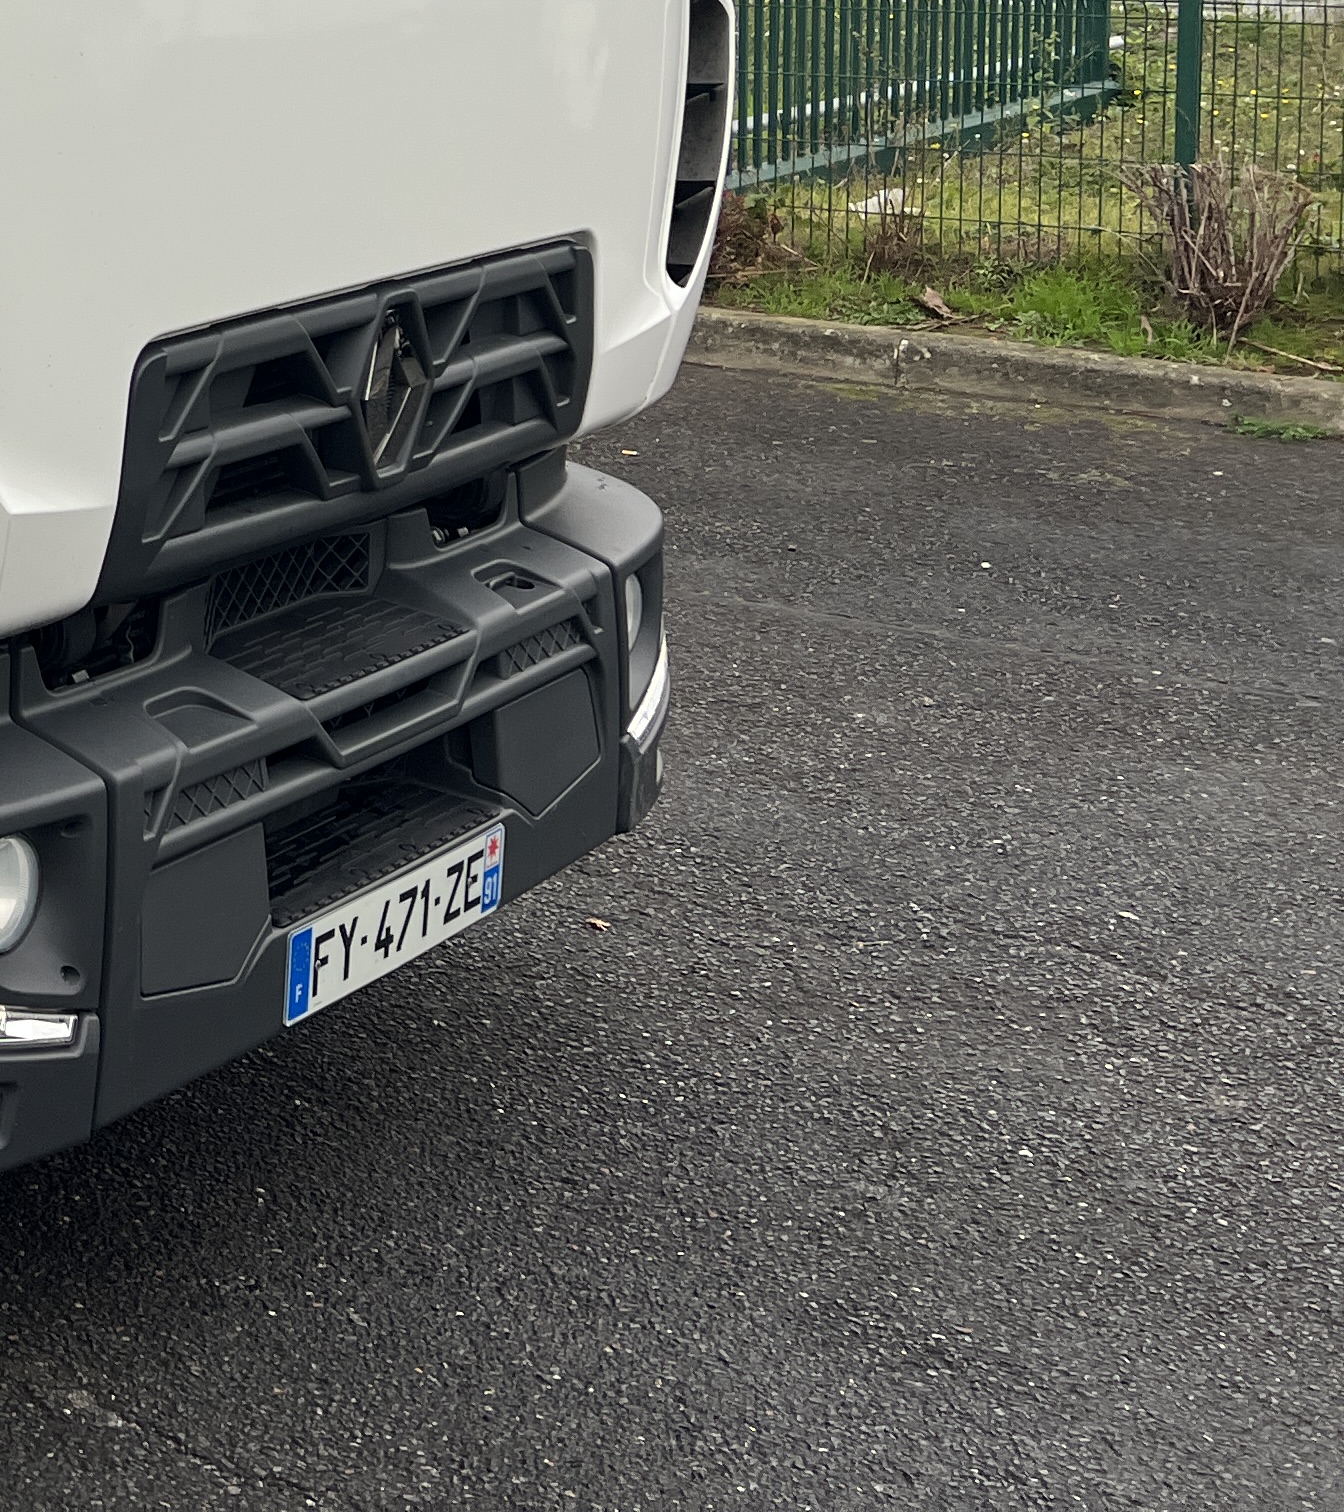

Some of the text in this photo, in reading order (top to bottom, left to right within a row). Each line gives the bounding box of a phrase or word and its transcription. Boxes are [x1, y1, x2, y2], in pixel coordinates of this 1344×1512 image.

[294, 848, 485, 1004] F FY-471-ZE
[483, 873, 499, 906] 91
